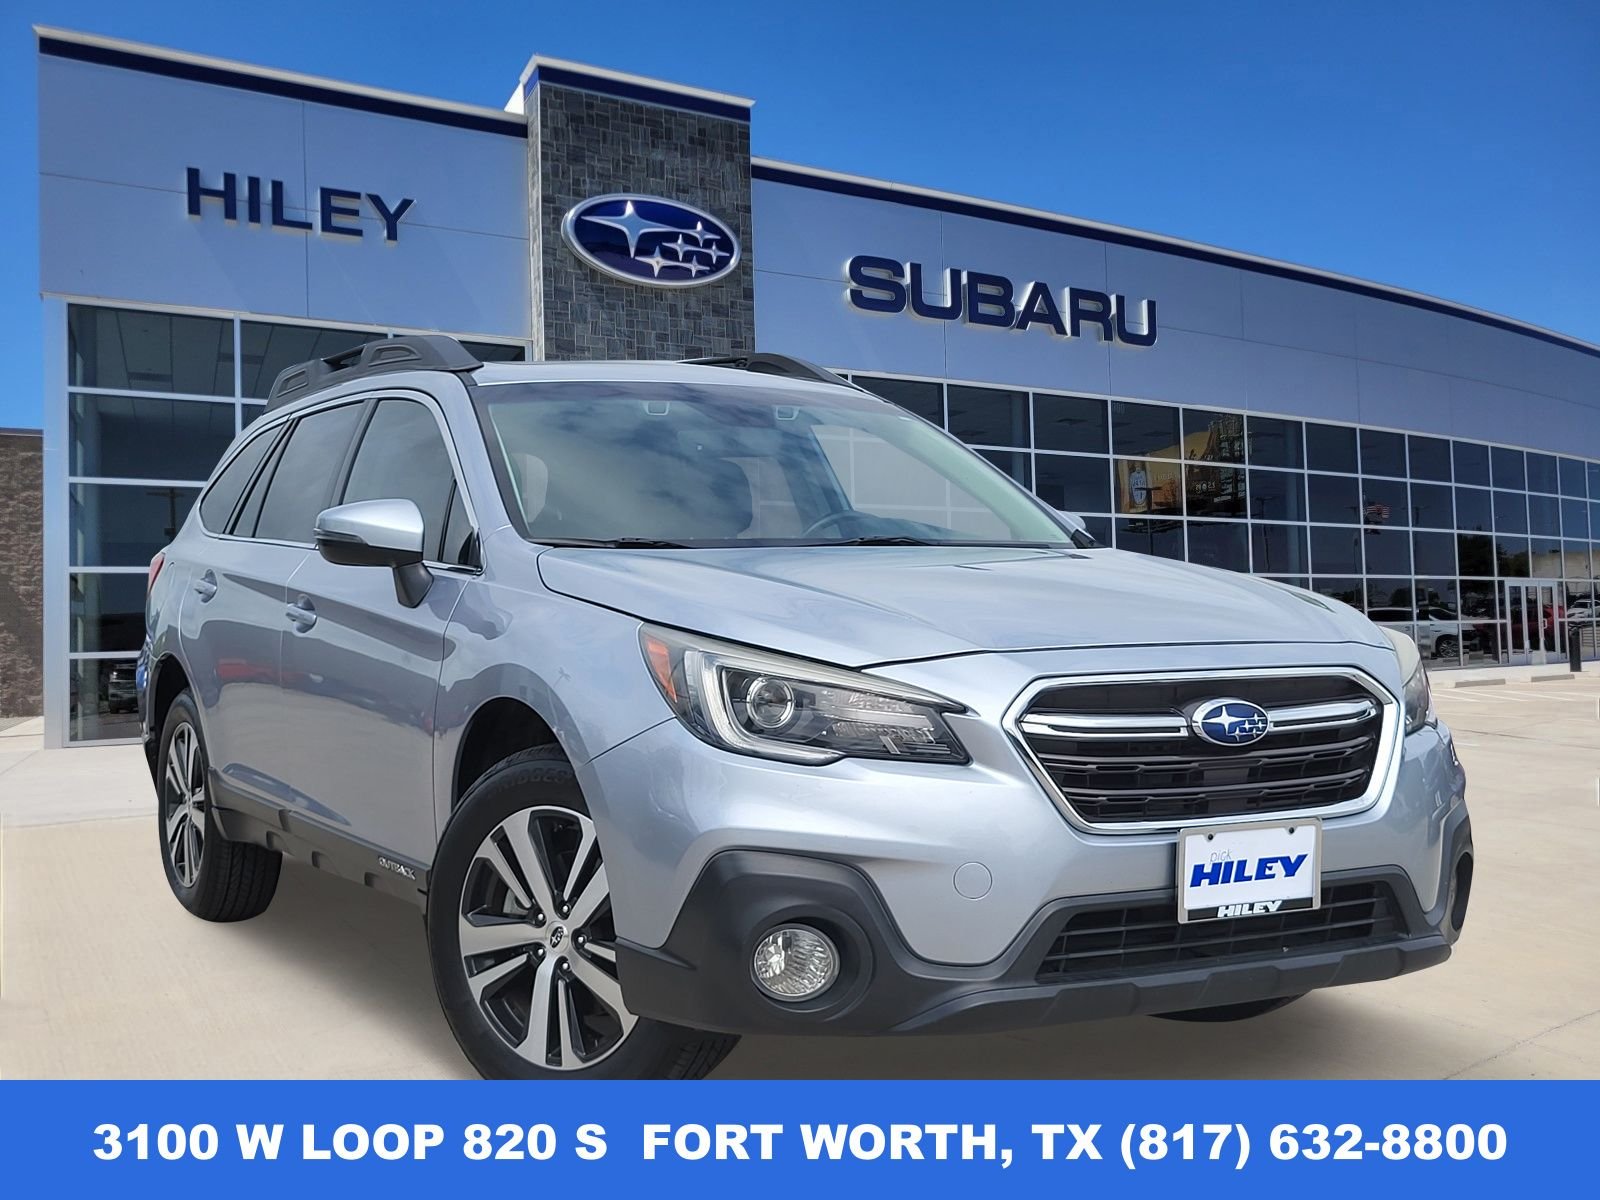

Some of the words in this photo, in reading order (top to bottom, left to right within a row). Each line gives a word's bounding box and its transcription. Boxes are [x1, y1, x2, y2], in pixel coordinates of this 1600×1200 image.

[186, 166, 415, 242] HILEY
[847, 255, 1158, 347] SUBARU
[1189, 853, 1309, 888] HILEY
[1217, 900, 1283, 918] HILEY
